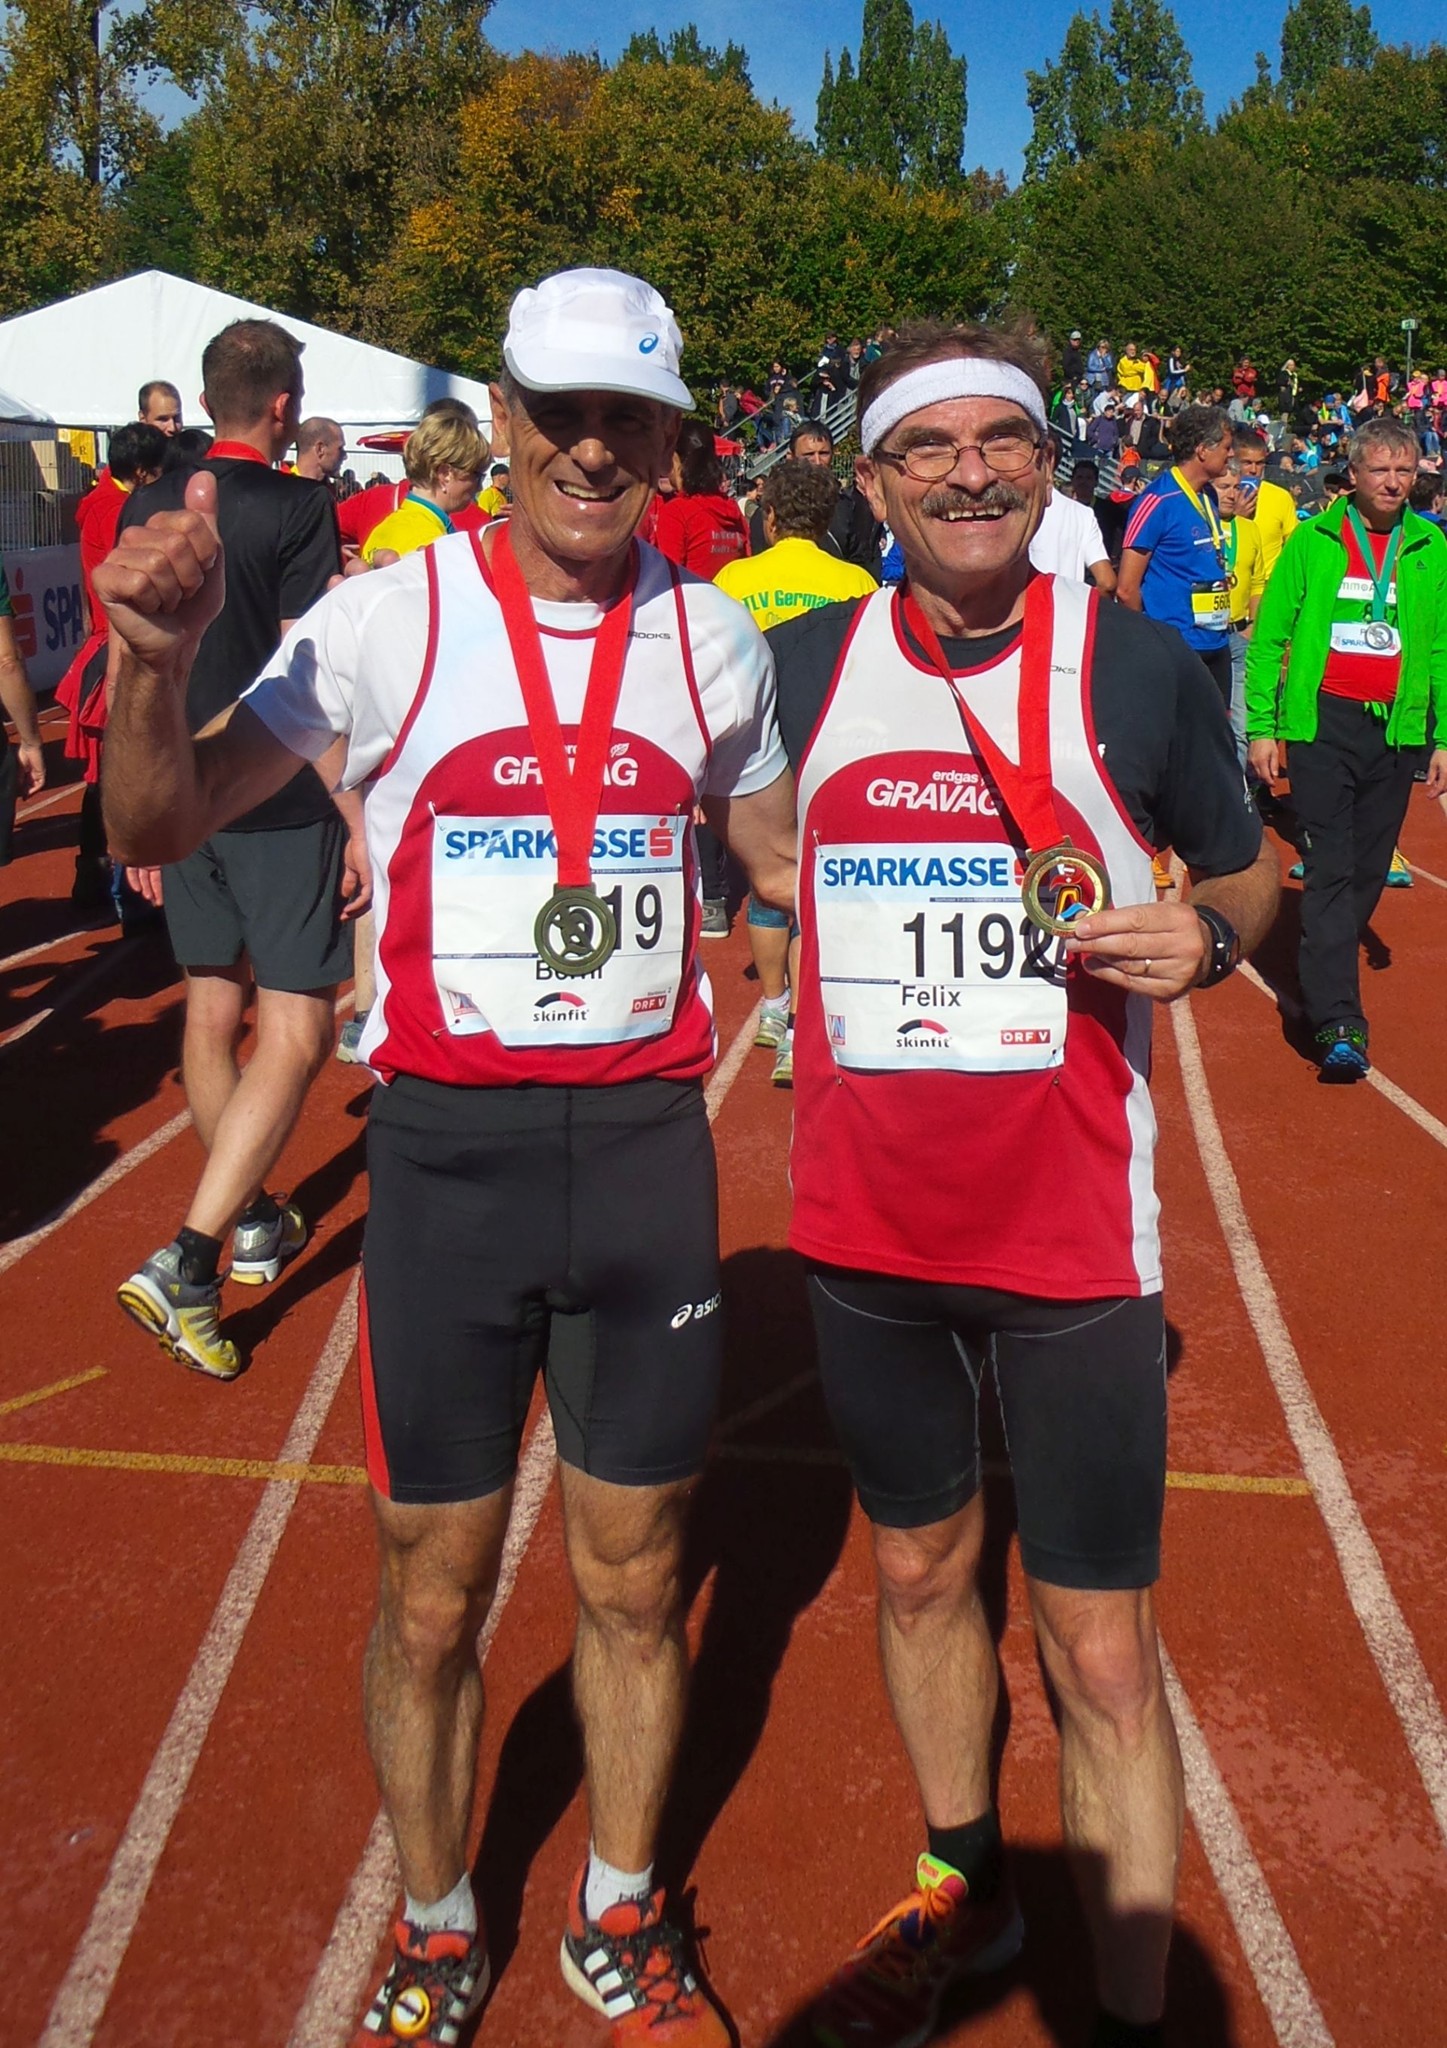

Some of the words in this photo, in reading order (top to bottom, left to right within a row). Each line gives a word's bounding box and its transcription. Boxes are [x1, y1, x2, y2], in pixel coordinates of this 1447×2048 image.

[774, 589, 842, 608] Germa
[932, 770, 979, 785] erdgas
[866, 778, 1001, 816] GRAVAG
[445, 829, 646, 859] SPARKSSE
[823, 856, 1009, 887] SPARKASSE
[901, 986, 961, 1007] Felix
[532, 1008, 588, 1022] skinfit
[896, 1035, 950, 1048] skinfit
[1002, 1031, 1034, 1043] ORF
